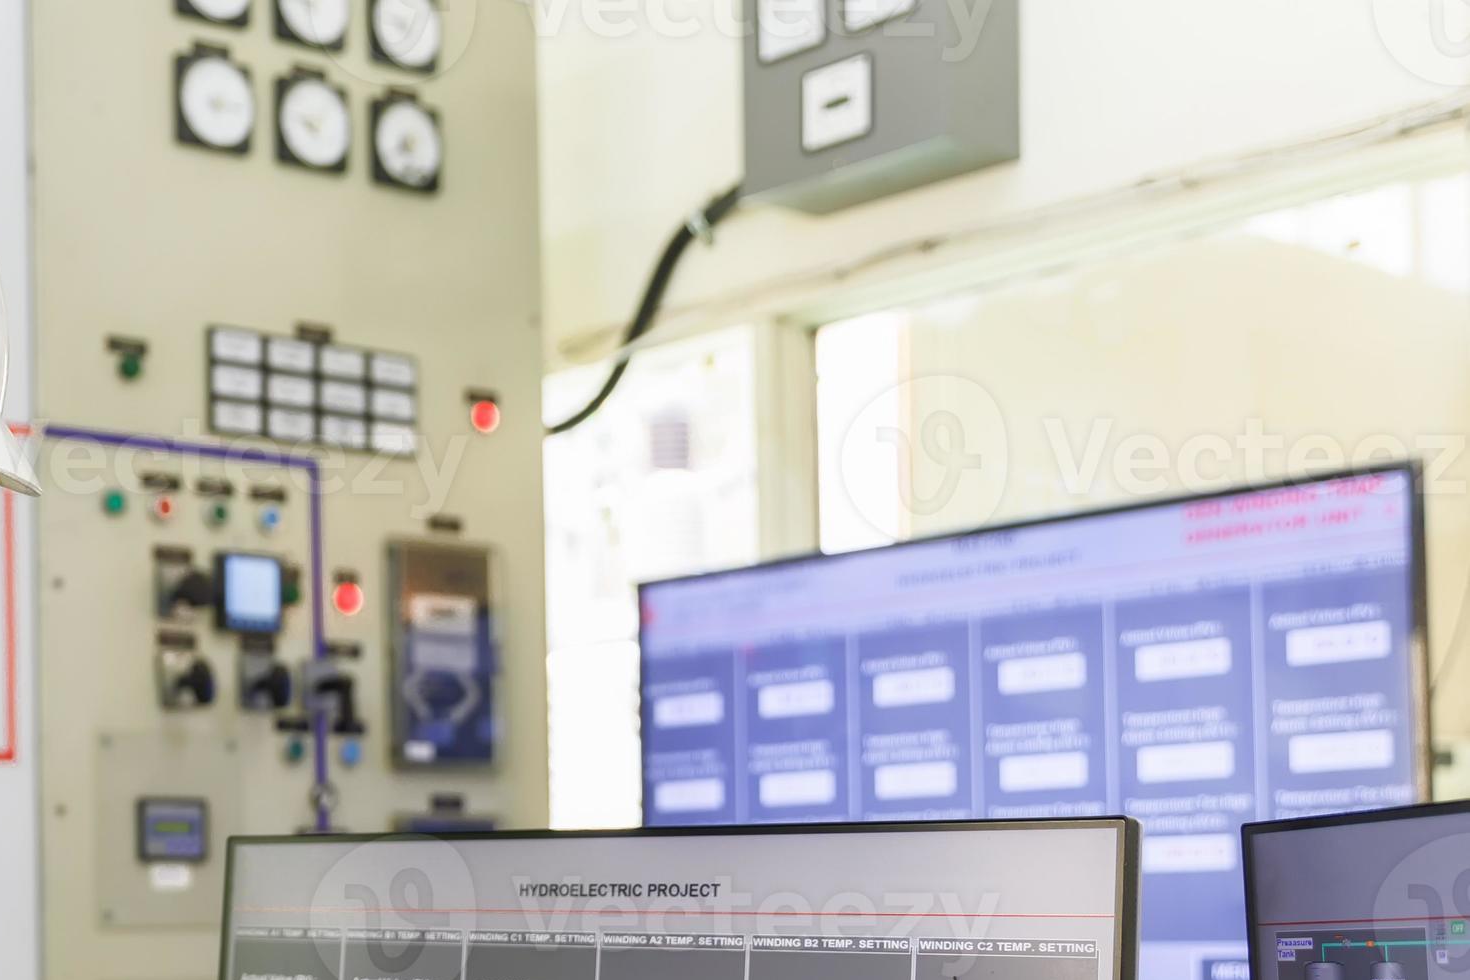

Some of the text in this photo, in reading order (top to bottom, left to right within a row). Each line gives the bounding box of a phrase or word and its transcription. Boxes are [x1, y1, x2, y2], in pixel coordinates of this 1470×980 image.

[519, 883, 721, 898] HYDROELECTRIC PROJECT
[603, 935, 743, 946] WINDING A2 TEMP. SETTING
[752, 937, 908, 950] WINDING B2 TEMP. SETTING
[919, 940, 1094, 953] WINDING C2 TEMP. SETTING
[1279, 950, 1294, 958] Tank
